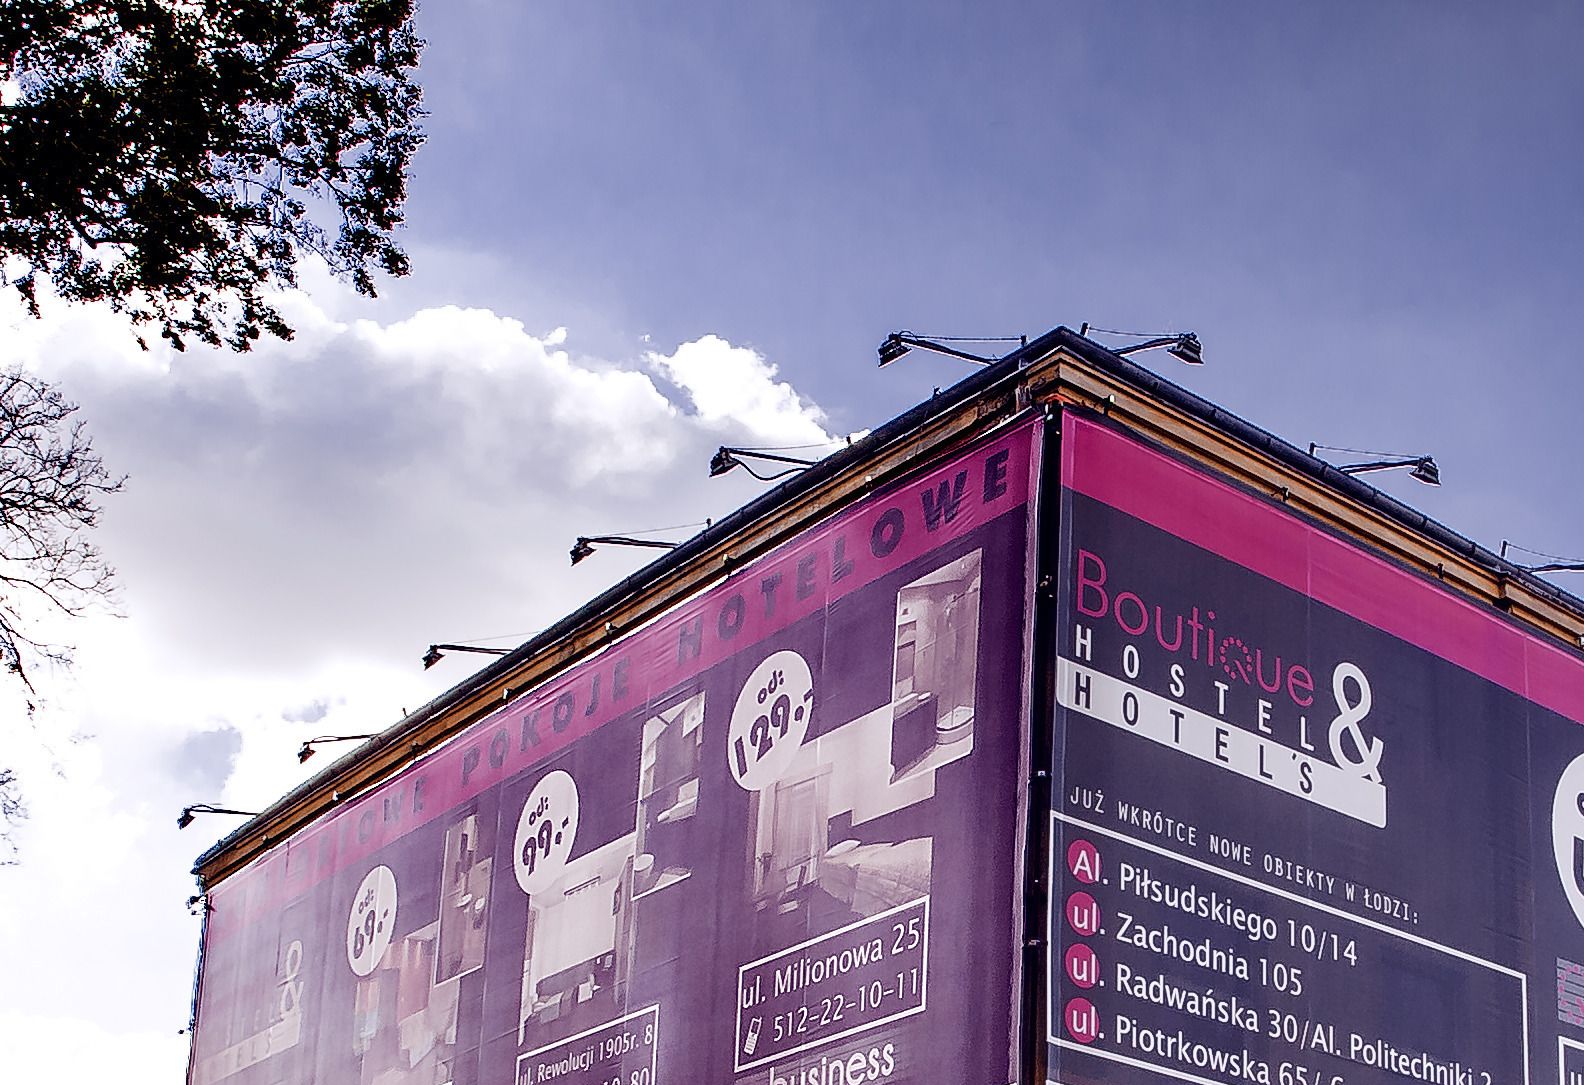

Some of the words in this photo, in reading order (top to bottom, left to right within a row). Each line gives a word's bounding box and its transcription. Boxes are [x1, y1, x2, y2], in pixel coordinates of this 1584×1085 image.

[462, 656, 632, 787] POKOJE
[677, 448, 1010, 668] HOTELOWE
[757, 669, 785, 704] od:
[1075, 623, 1315, 752] HOSTEL
[1328, 662, 1385, 785] &
[1070, 786, 1105, 814] JUŻ
[1117, 800, 1198, 847] WKRÓTCE
[1209, 834, 1252, 866] NOWE
[1263, 854, 1335, 895] OBIEKTY
[1345, 882, 1357, 902] W
[1363, 888, 1419, 924] ŁODZI:
[1072, 898, 1106, 936] ul.
[1116, 913, 1249, 981] Zachodnia
[1260, 957, 1302, 996] 105
[1073, 849, 1109, 886] Al.
[1119, 863, 1277, 948] Piłsudskiego
[1287, 919, 1358, 967] 10/14
[742, 975, 766, 1010] ul.
[774, 937, 883, 999] Milionowa
[891, 917, 920, 955] 25
[773, 967, 919, 1043] 512-22-10-11
[1072, 951, 1105, 987] ul.
[1116, 963, 1259, 1033] Radwańska
[537, 1045, 594, 1083] Rewolucji
[599, 1032, 640, 1062] 1905r.
[644, 1024, 654, 1045] 8
[1072, 1005, 1105, 1040] ul.
